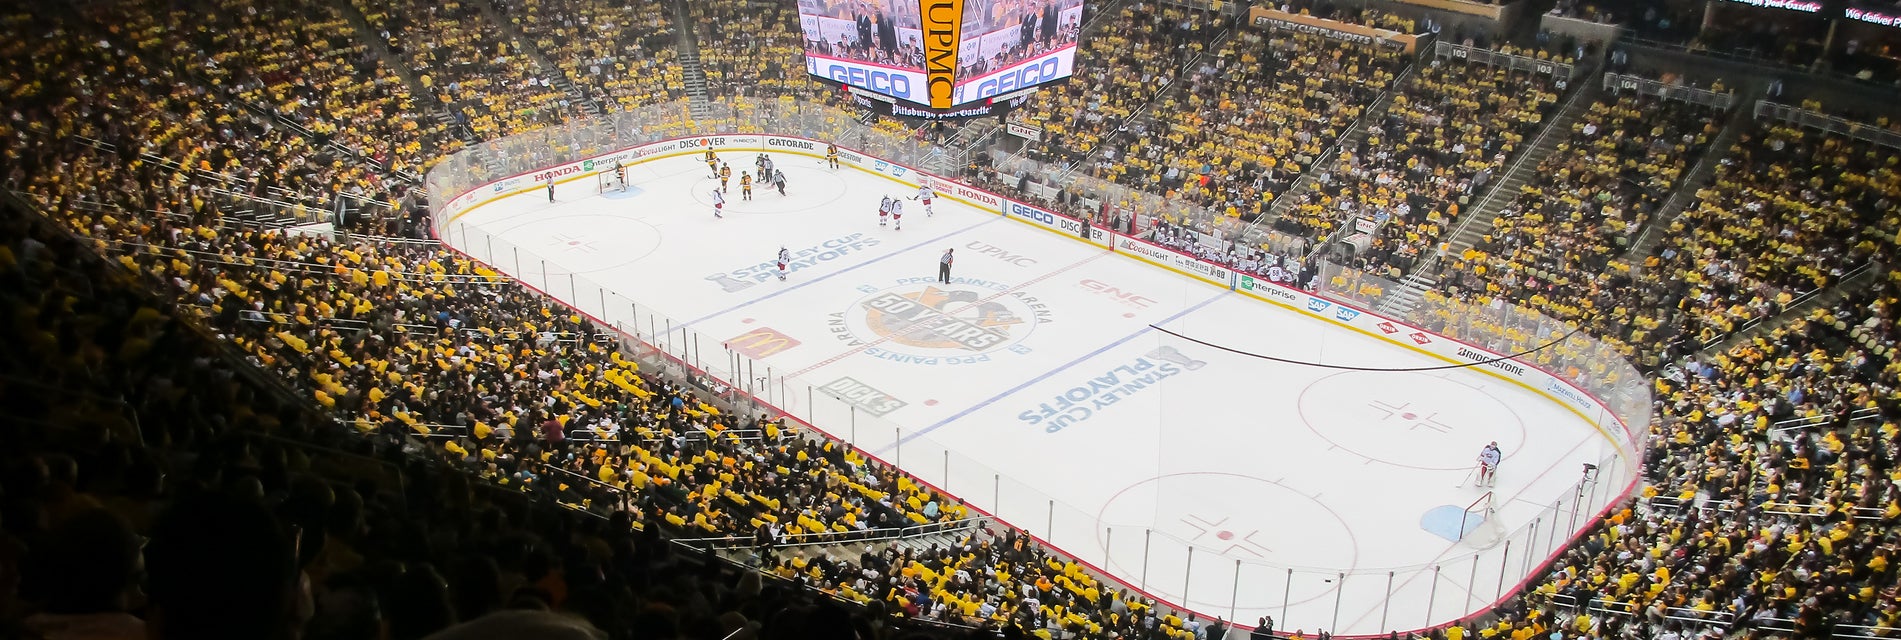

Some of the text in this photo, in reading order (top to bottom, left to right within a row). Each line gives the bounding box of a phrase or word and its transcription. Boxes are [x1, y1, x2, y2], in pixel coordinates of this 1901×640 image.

[1845, 8, 1861, 20] We
[1861, 11, 1893, 26] deliver
[1298, 24, 1319, 34] CUP
[1318, 28, 1371, 45] PLAYOFFS
[928, 0, 953, 101] UPMC
[1453, 48, 1467, 58] 103
[977, 56, 1059, 99] GEICO
[1536, 64, 1553, 75] 103
[829, 64, 910, 99] GEICO
[1620, 80, 1638, 91] 104
[1011, 126, 1034, 136] GNC
[658, 144, 676, 153] LIGHT
[680, 137, 726, 149] DISCOVER
[768, 138, 814, 150] GATORADE
[534, 164, 581, 182] HONDA
[957, 188, 998, 207] HONDA
[1012, 204, 1054, 225] GEICO
[1357, 221, 1374, 230] GNC
[822, 232, 863, 249] CUP
[1127, 240, 1149, 255] Coors
[1149, 250, 1169, 262] LIGHT
[752, 237, 881, 283] PLAYOFFS
[965, 239, 1038, 268] UPMC
[896, 276, 938, 286] PPG
[1012, 291, 1053, 324] ARENA
[1079, 277, 1157, 308] GNC
[1309, 297, 1326, 311] SAP
[1336, 306, 1355, 320] SAP
[870, 293, 1001, 349] 50 YEARS
[828, 311, 992, 365] PPG PAINTS ARENA
[1412, 335, 1428, 344] ORKIN
[1457, 347, 1525, 377] BRIDGESTONE
[829, 377, 902, 416] DICK'S
[1017, 357, 1155, 425] PLAYOFFS
[1045, 362, 1181, 434] STANLEY CUP
